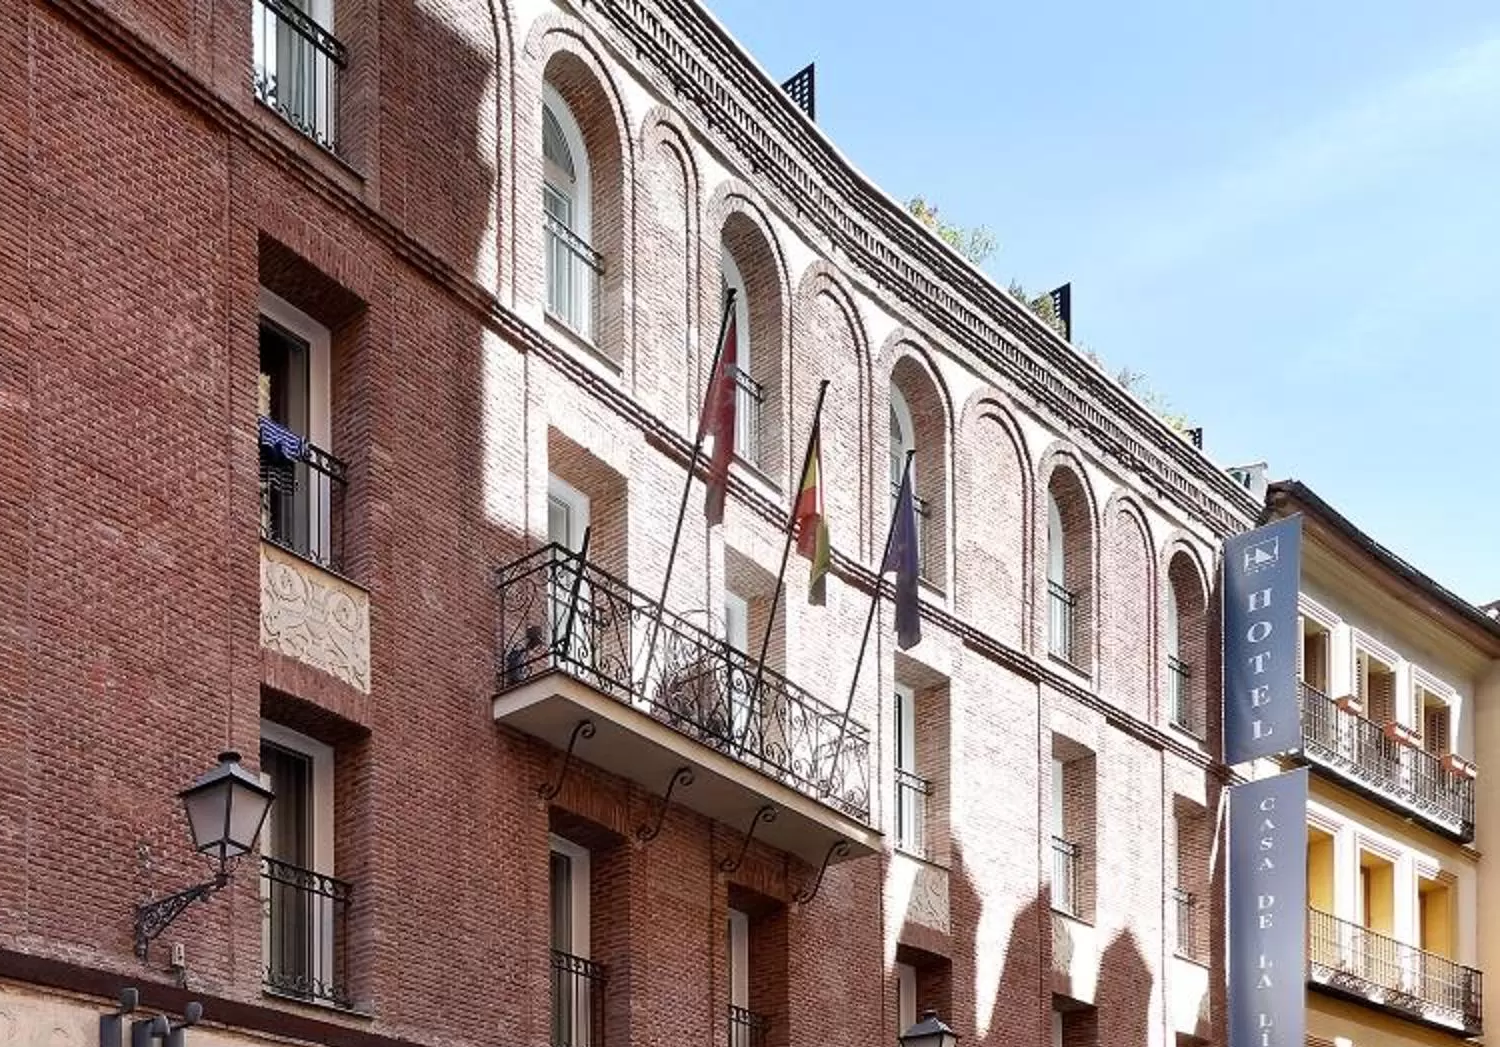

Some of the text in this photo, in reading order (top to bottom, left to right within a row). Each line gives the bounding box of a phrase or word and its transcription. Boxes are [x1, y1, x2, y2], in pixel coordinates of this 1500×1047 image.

[1247, 587, 1273, 741] HOTEL
[1259, 796, 1276, 872] CASA
[1258, 894, 1276, 930] DE
[1257, 952, 1274, 990] LA
